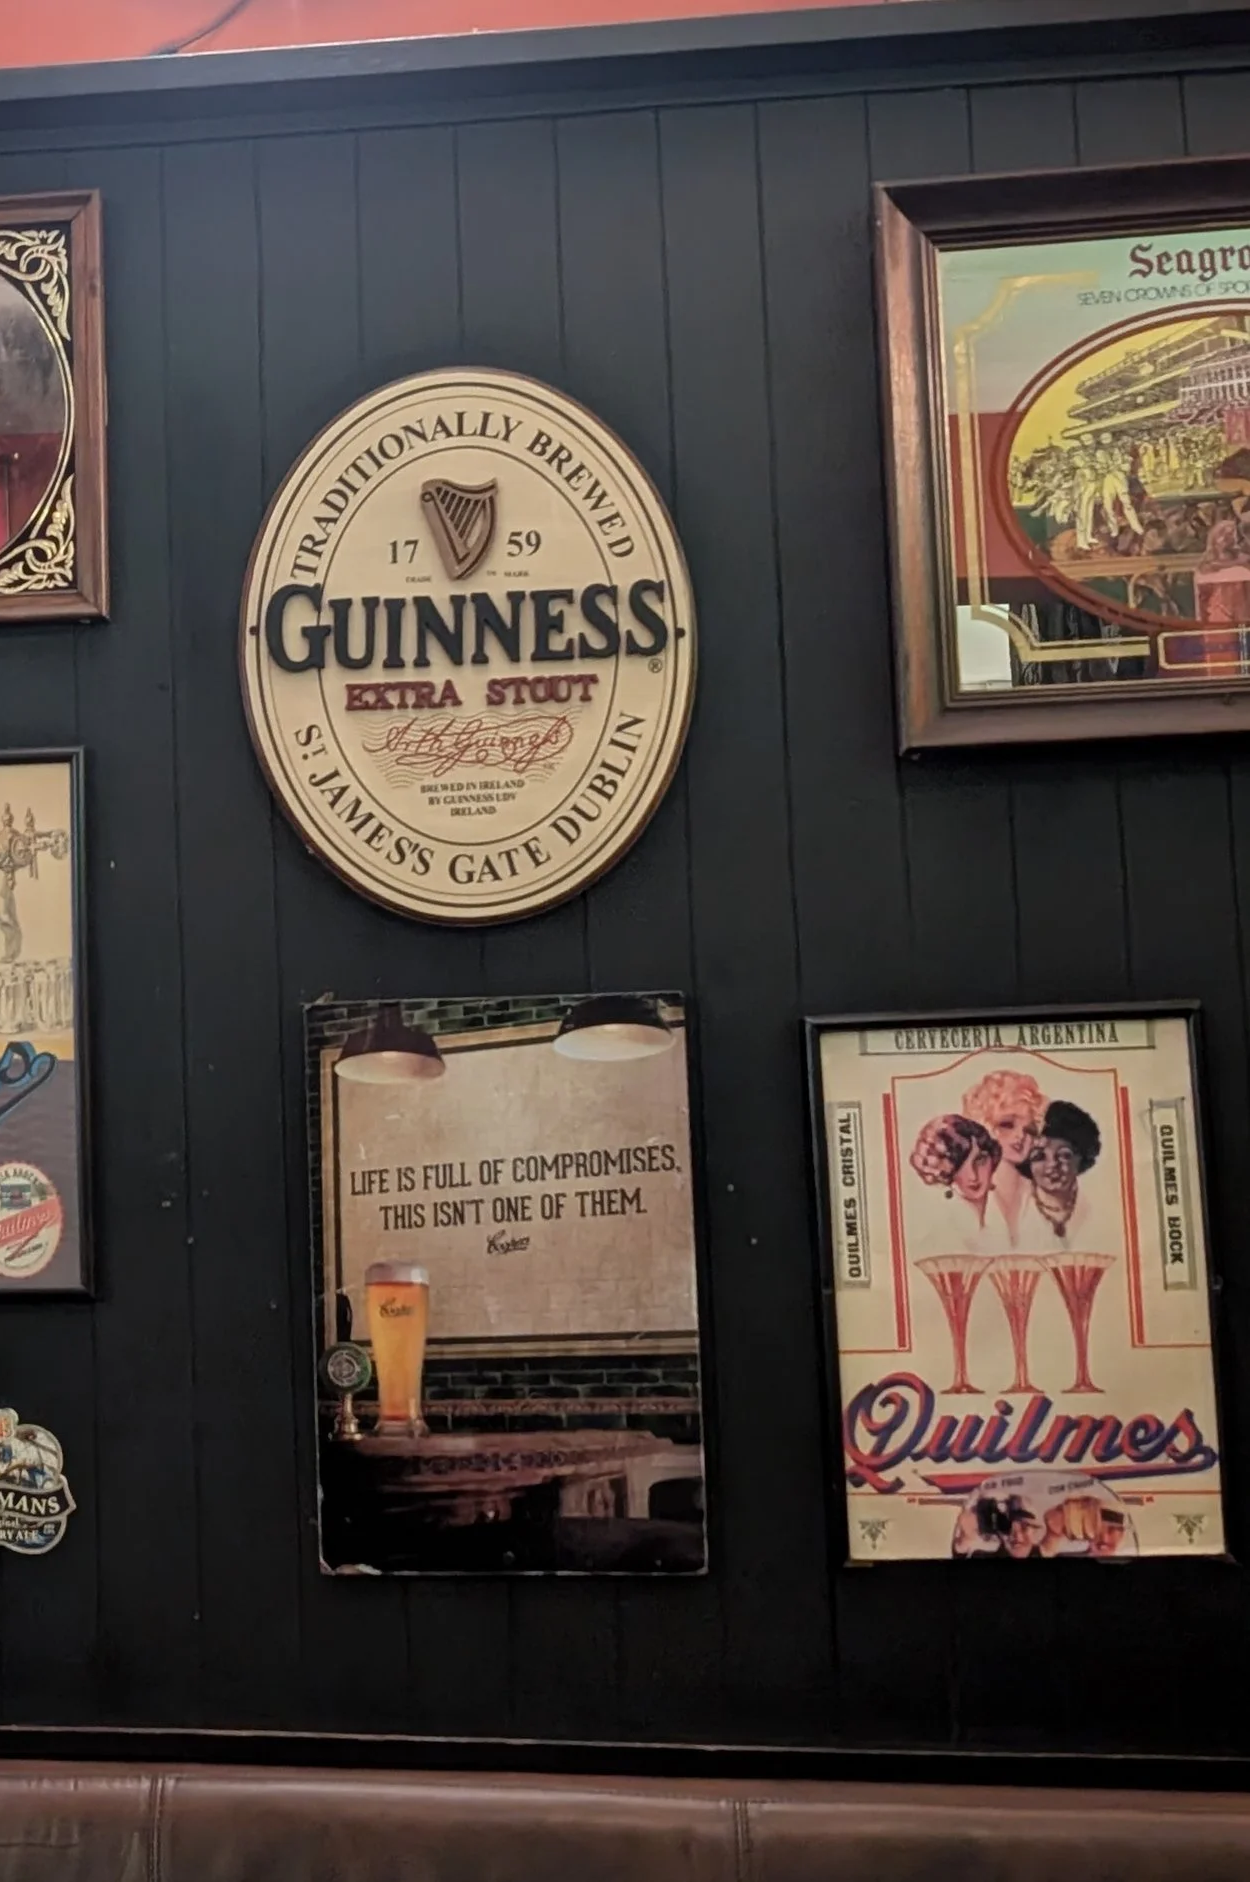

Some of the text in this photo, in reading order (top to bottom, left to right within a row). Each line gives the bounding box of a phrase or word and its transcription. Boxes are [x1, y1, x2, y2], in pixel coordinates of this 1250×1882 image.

[1077, 290, 1122, 306] SEVEN
[1125, 284, 1191, 302] CROWNS
[1195, 282, 1211, 297] OF
[291, 411, 636, 579] TRADITIONALLY BREWED
[389, 529, 542, 565] 17 59
[265, 579, 668, 672] GUINNESS
[345, 674, 599, 711] EXTRA STOUT
[308, 767, 435, 876] JAMES'S
[448, 838, 553, 885] GATE
[551, 711, 647, 847] DUBLIN
[420, 779, 526, 794] BREWED IN IRELAND
[428, 796, 441, 805] BY
[443, 794, 495, 805] GUINNESS
[450, 806, 497, 817] IRELAND
[894, 1021, 1120, 1050] CERVECERIA ARGENTINA
[350, 1168, 391, 1196] LIFE
[397, 1166, 415, 1193] IS
[422, 1162, 472, 1190] FULL
[479, 1158, 504, 1186] OF
[838, 1112, 862, 1278] QUILMES CRISTAL
[1160, 1124, 1184, 1264] QUILMES BOCK
[379, 1187, 647, 1231] THIS ISN'T ONE OF THEM.
[843, 1372, 1218, 1493] Quilmes
